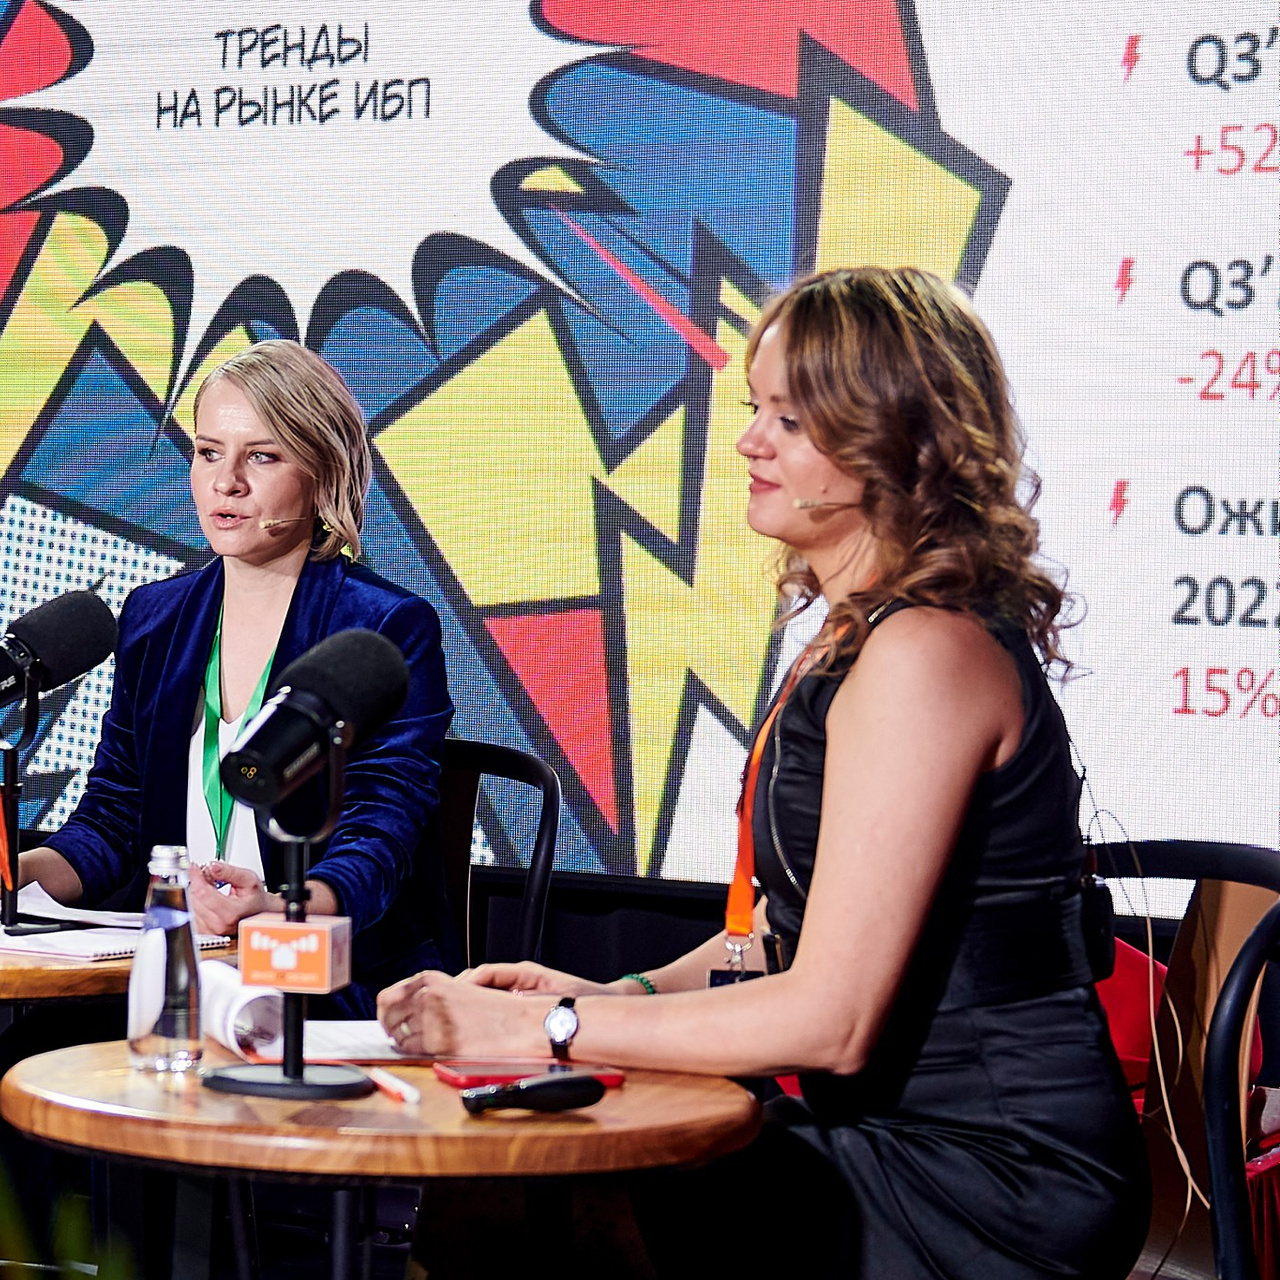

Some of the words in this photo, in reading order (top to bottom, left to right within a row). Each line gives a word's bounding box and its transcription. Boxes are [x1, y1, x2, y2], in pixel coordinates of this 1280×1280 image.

[215, 23, 368, 70] ТРЕНДЫ
[156, 88, 202, 128] НА
[214, 78, 340, 127] РЫНКЕ
[354, 77, 431, 122] ИБП
[1171, 575, 1280, 628] 202
[1172, 667, 1280, 718] 15%
